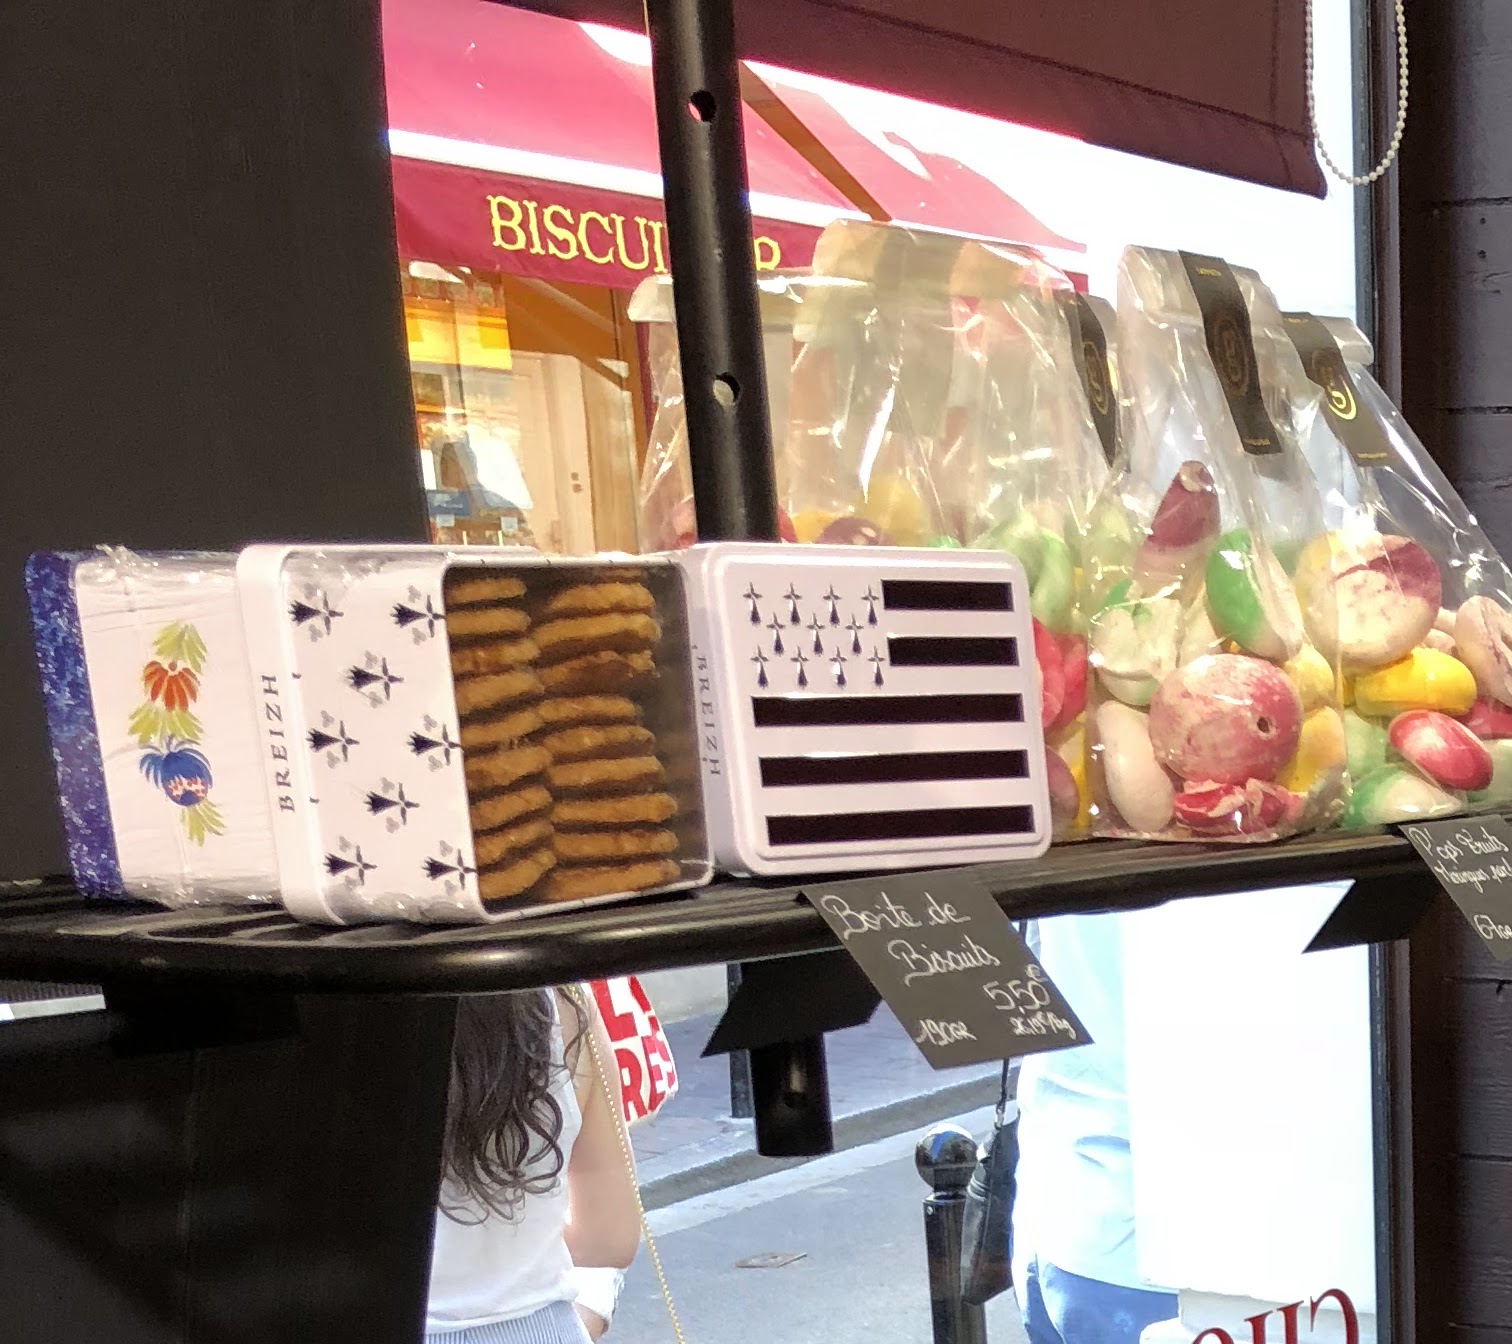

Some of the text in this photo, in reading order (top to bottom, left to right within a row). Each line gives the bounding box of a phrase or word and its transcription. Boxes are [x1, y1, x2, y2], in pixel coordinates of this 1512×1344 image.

[261, 675, 295, 812] BREIZH
[698, 657, 721, 775] BREIZH
[925, 892, 971, 926] de
[888, 934, 1000, 987] Biscuits
